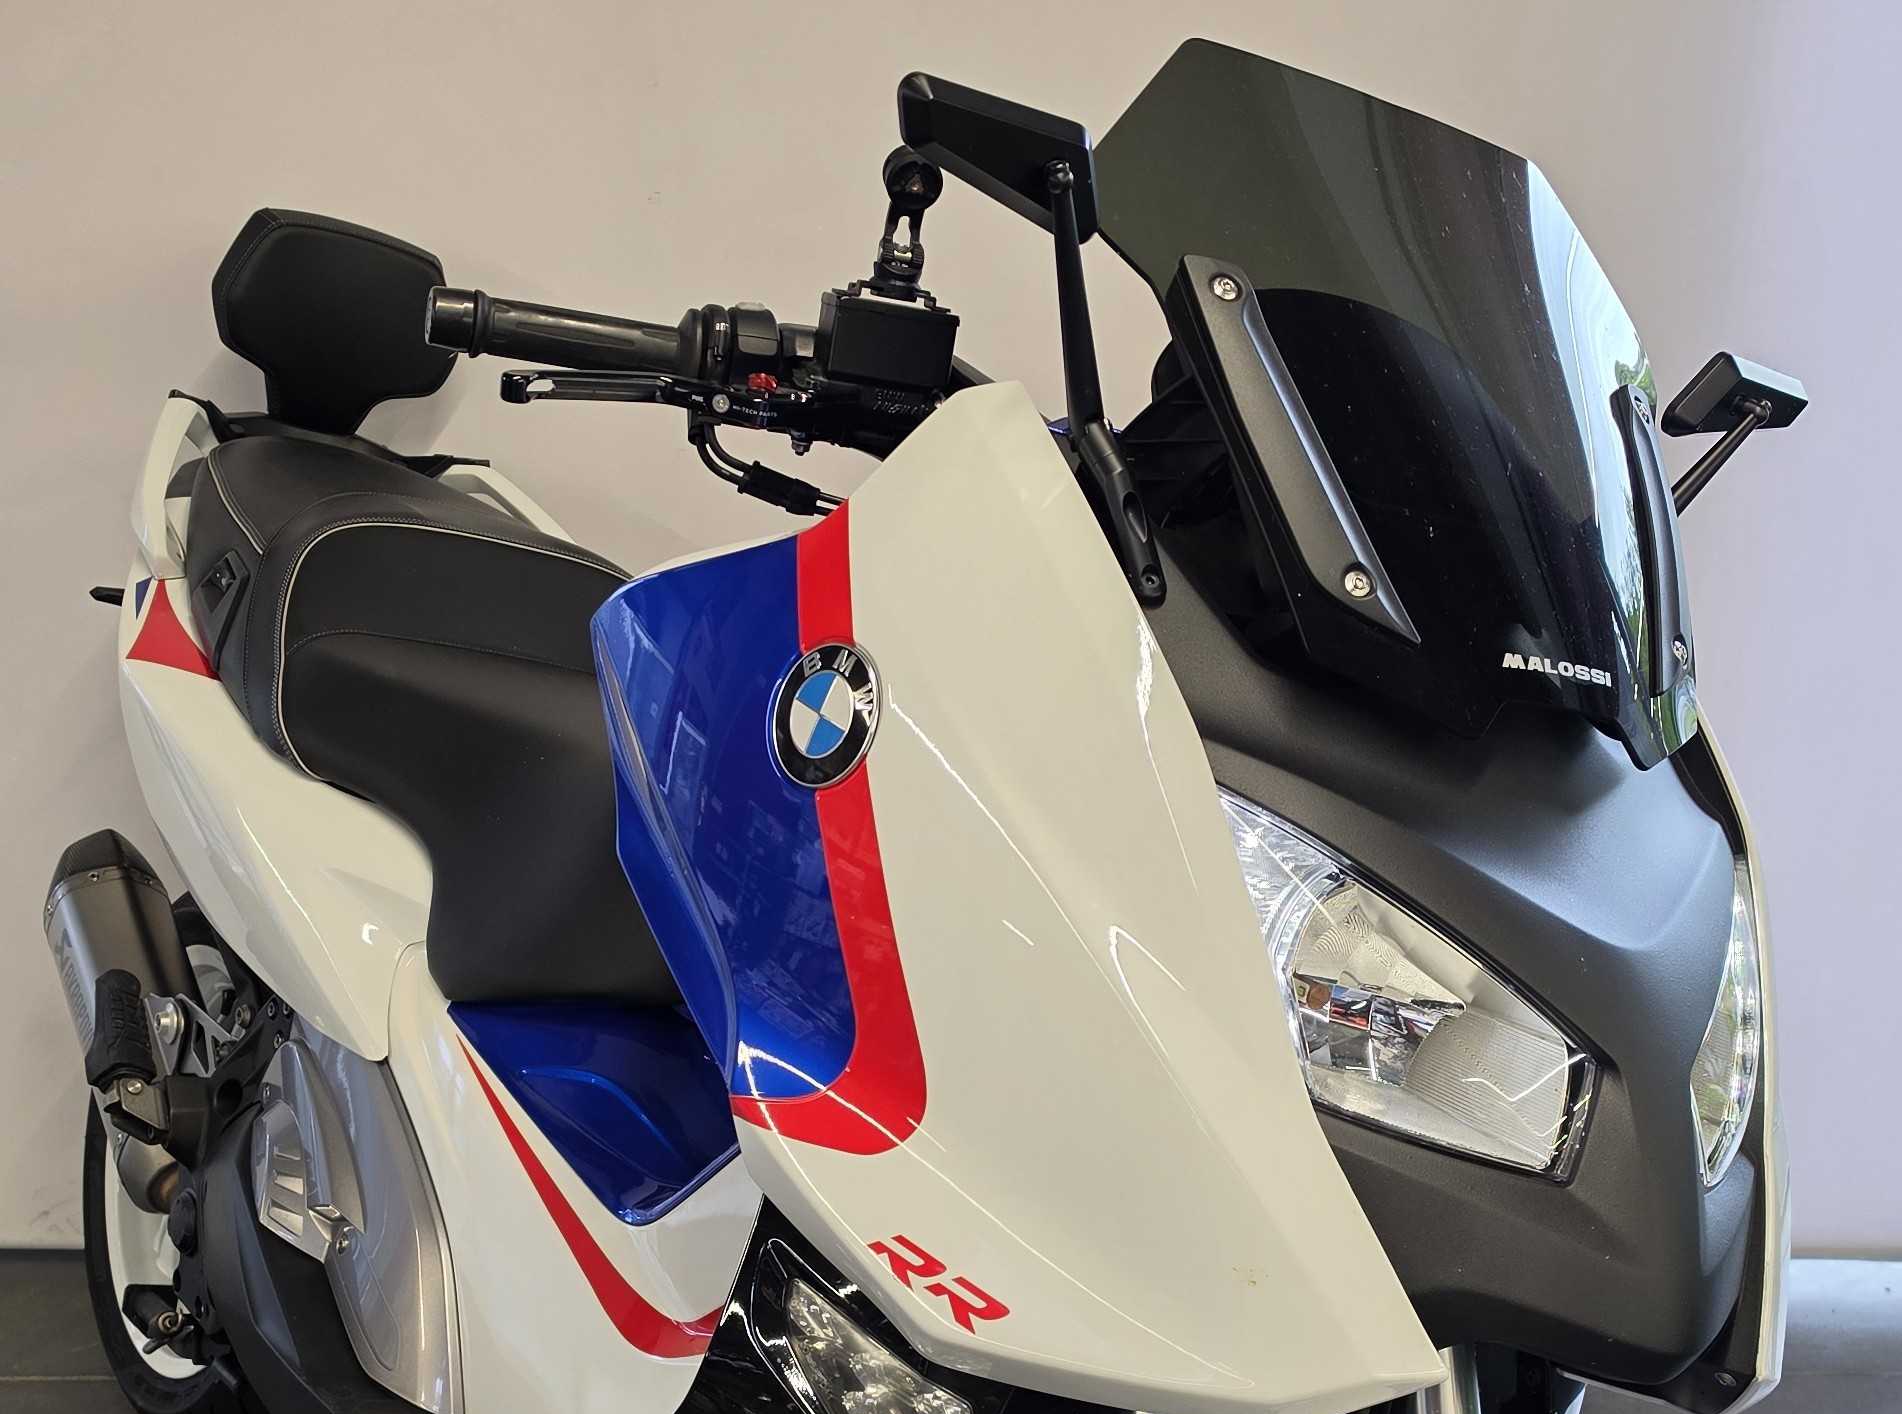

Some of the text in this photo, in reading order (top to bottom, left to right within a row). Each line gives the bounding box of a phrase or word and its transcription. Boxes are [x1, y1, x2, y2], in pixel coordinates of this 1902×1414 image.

[802, 649, 873, 722] BMW
[1502, 652, 1612, 688] MALOSSI
[867, 1234, 1010, 1335] RR
